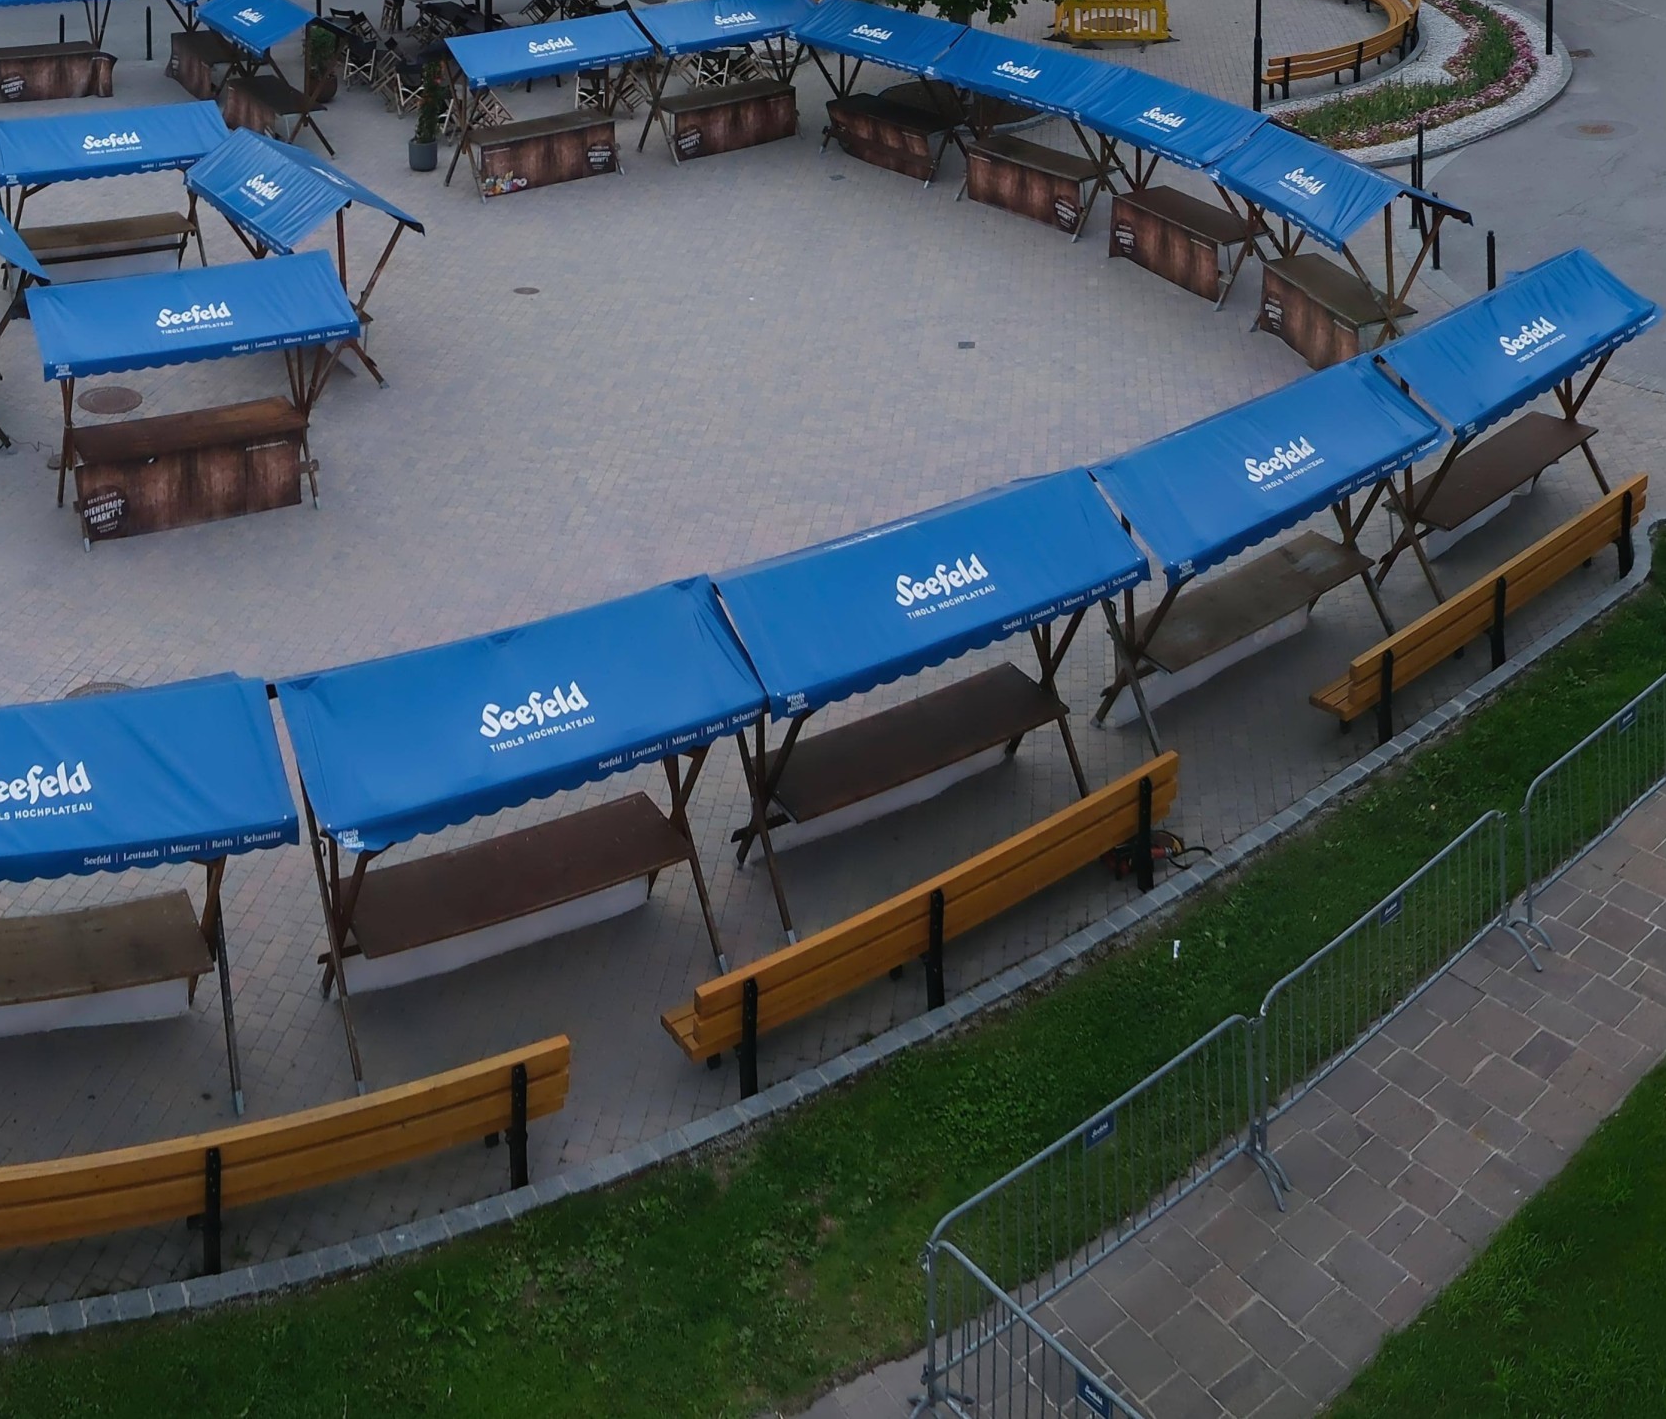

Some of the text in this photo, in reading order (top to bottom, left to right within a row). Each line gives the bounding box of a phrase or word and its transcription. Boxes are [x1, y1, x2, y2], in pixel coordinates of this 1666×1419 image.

[715, 11, 757, 28] Seefeld
[853, 24, 892, 41] Seefeld
[528, 35, 575, 54] Seefeld
[997, 60, 1041, 79] Seefeld
[1143, 107, 1186, 128] Seefeld
[82, 131, 141, 150] Seefeld
[246, 173, 284, 201] Seefeld
[1285, 167, 1326, 196] Seefeld
[156, 301, 232, 328] Seefeld
[1499, 316, 1557, 356] Seefeld
[1245, 435, 1316, 483] Seefeld
[1260, 457, 1325, 493] TIROLS HOCHPLATEAU
[87, 491, 117, 504] SEEFELDER
[896, 553, 989, 607] Seefeld
[906, 584, 996, 620] TIROLS HOCHPLATEAU
[480, 681, 590, 737] Seefeld
[489, 715, 596, 753] TIROLS HOCHPLATEAU
[598, 707, 764, 771] Seefeld Leutasch Mösern Reith Scharnitz
[14, 801, 93, 820] HOCHPLATEAU
[83, 830, 282, 866] Seefeld Leutasch Mösern Reith Scharnitz
